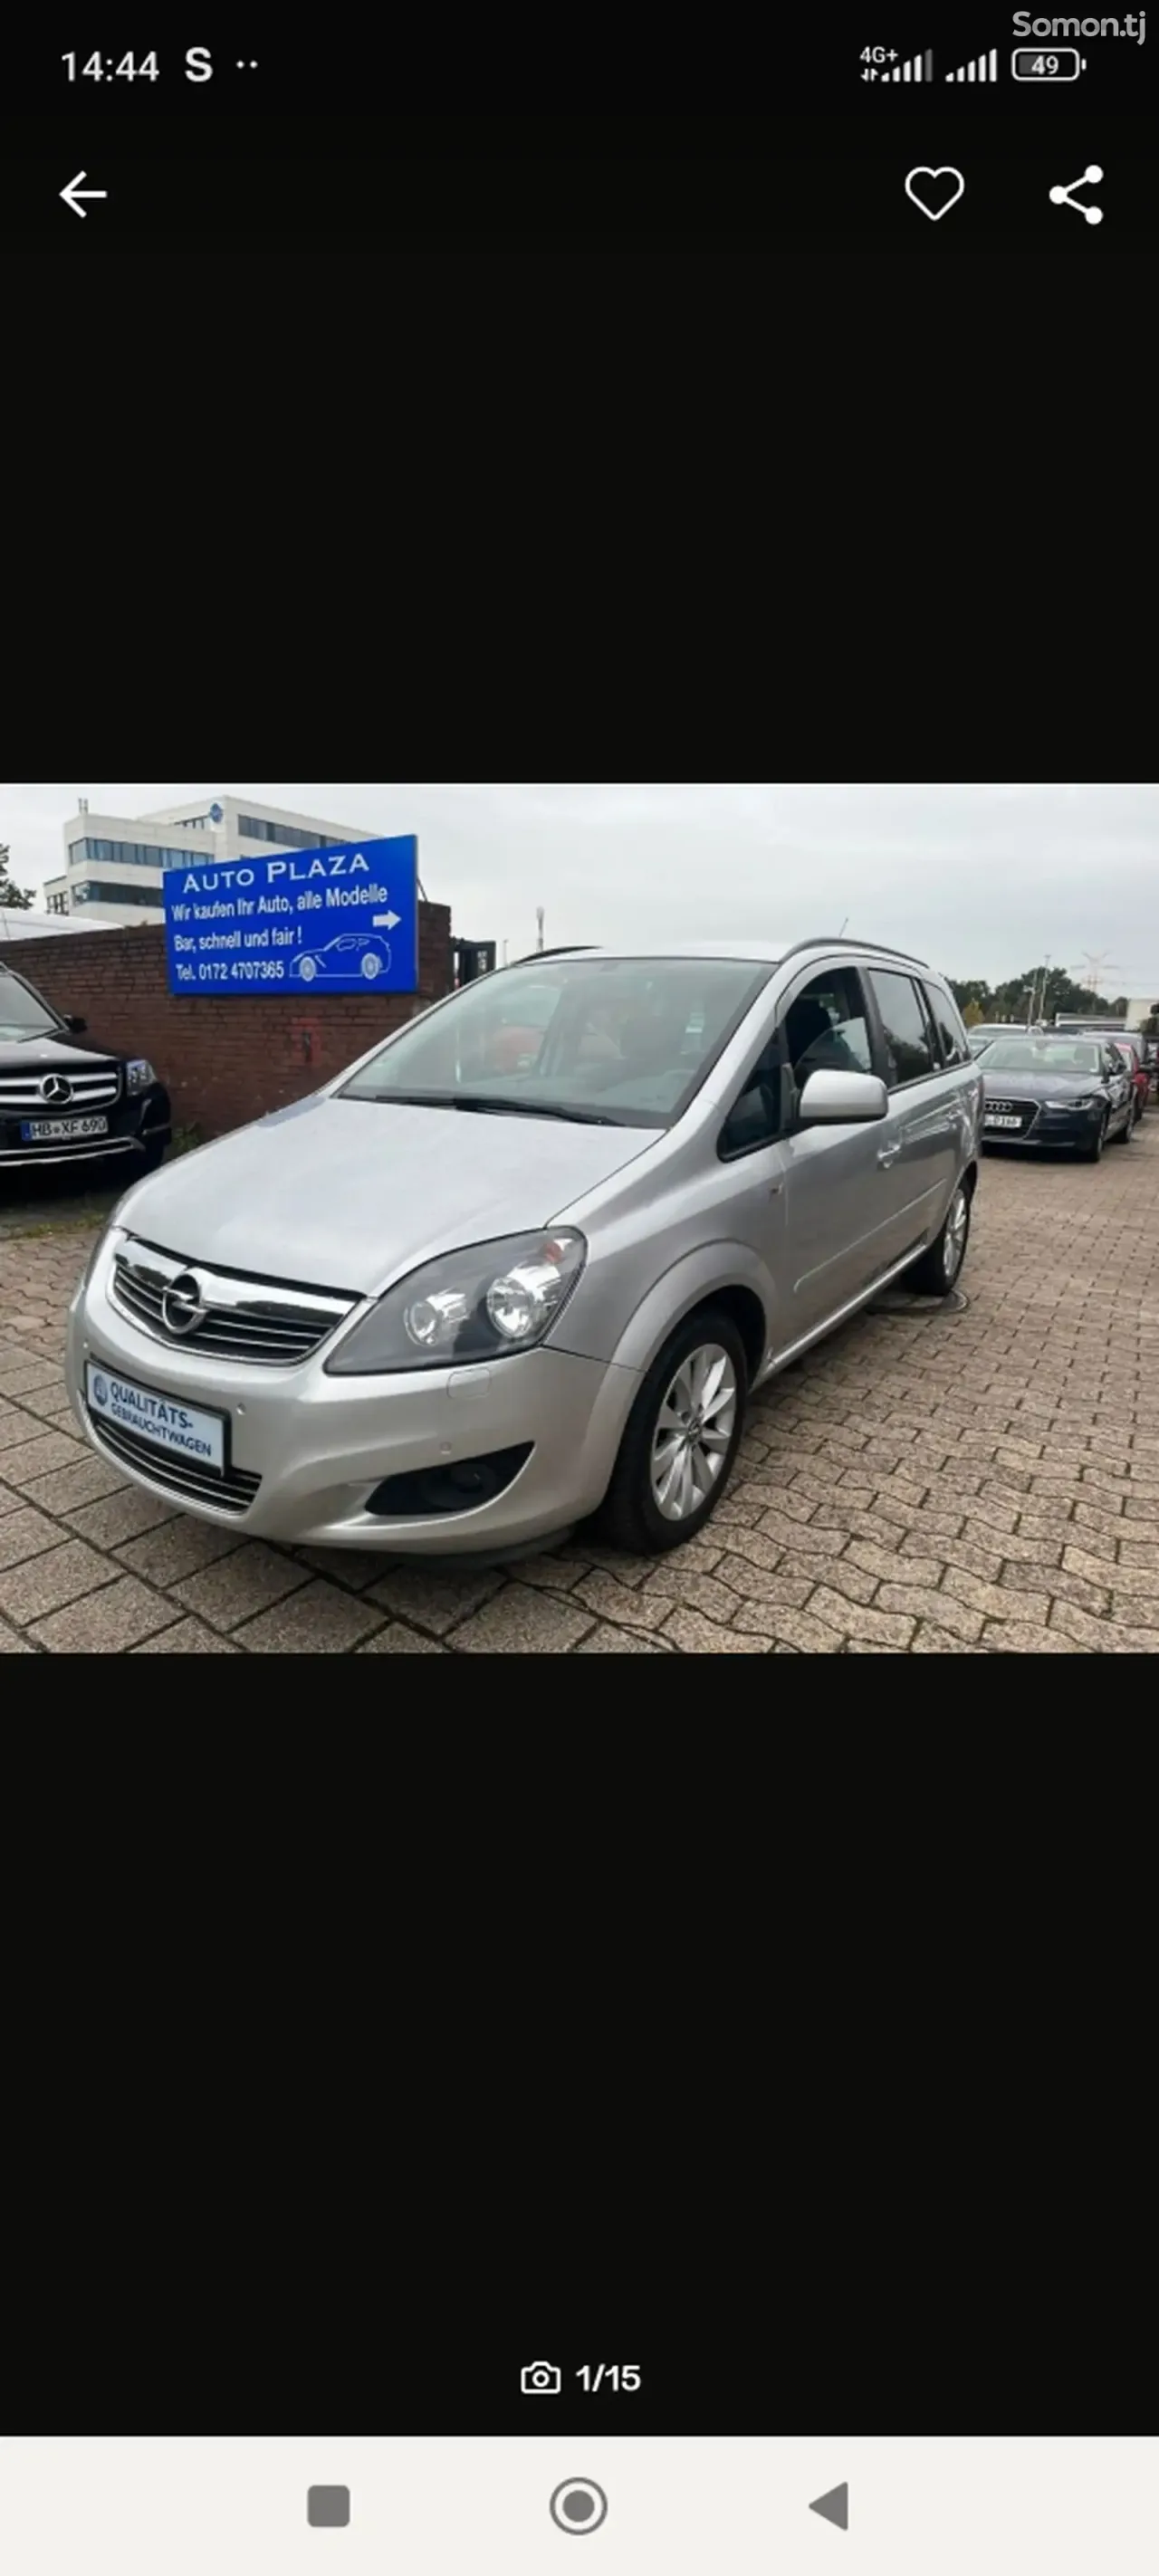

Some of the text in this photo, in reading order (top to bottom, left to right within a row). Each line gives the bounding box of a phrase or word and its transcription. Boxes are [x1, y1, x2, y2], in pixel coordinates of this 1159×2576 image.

[61, 50, 160, 82] 14:44
[860, 45, 899, 63] 4G+
[1030, 54, 1059, 75] 49
[183, 853, 370, 894] AUTO PLAZA
[171, 884, 388, 922] Wir kaufen Ihr Auto, alle Modelle
[174, 934, 196, 953] Bar,
[198, 931, 242, 950] schnell
[244, 928, 269, 947] und
[272, 926, 294, 945] fair
[176, 960, 284, 982] Tel. 0172 4707365
[110, 1382, 194, 1429] QUALITÄTS-
[110, 1403, 212, 1457] GEBRAUCHTWAGEN
[575, 2363, 641, 2392] 1/15
